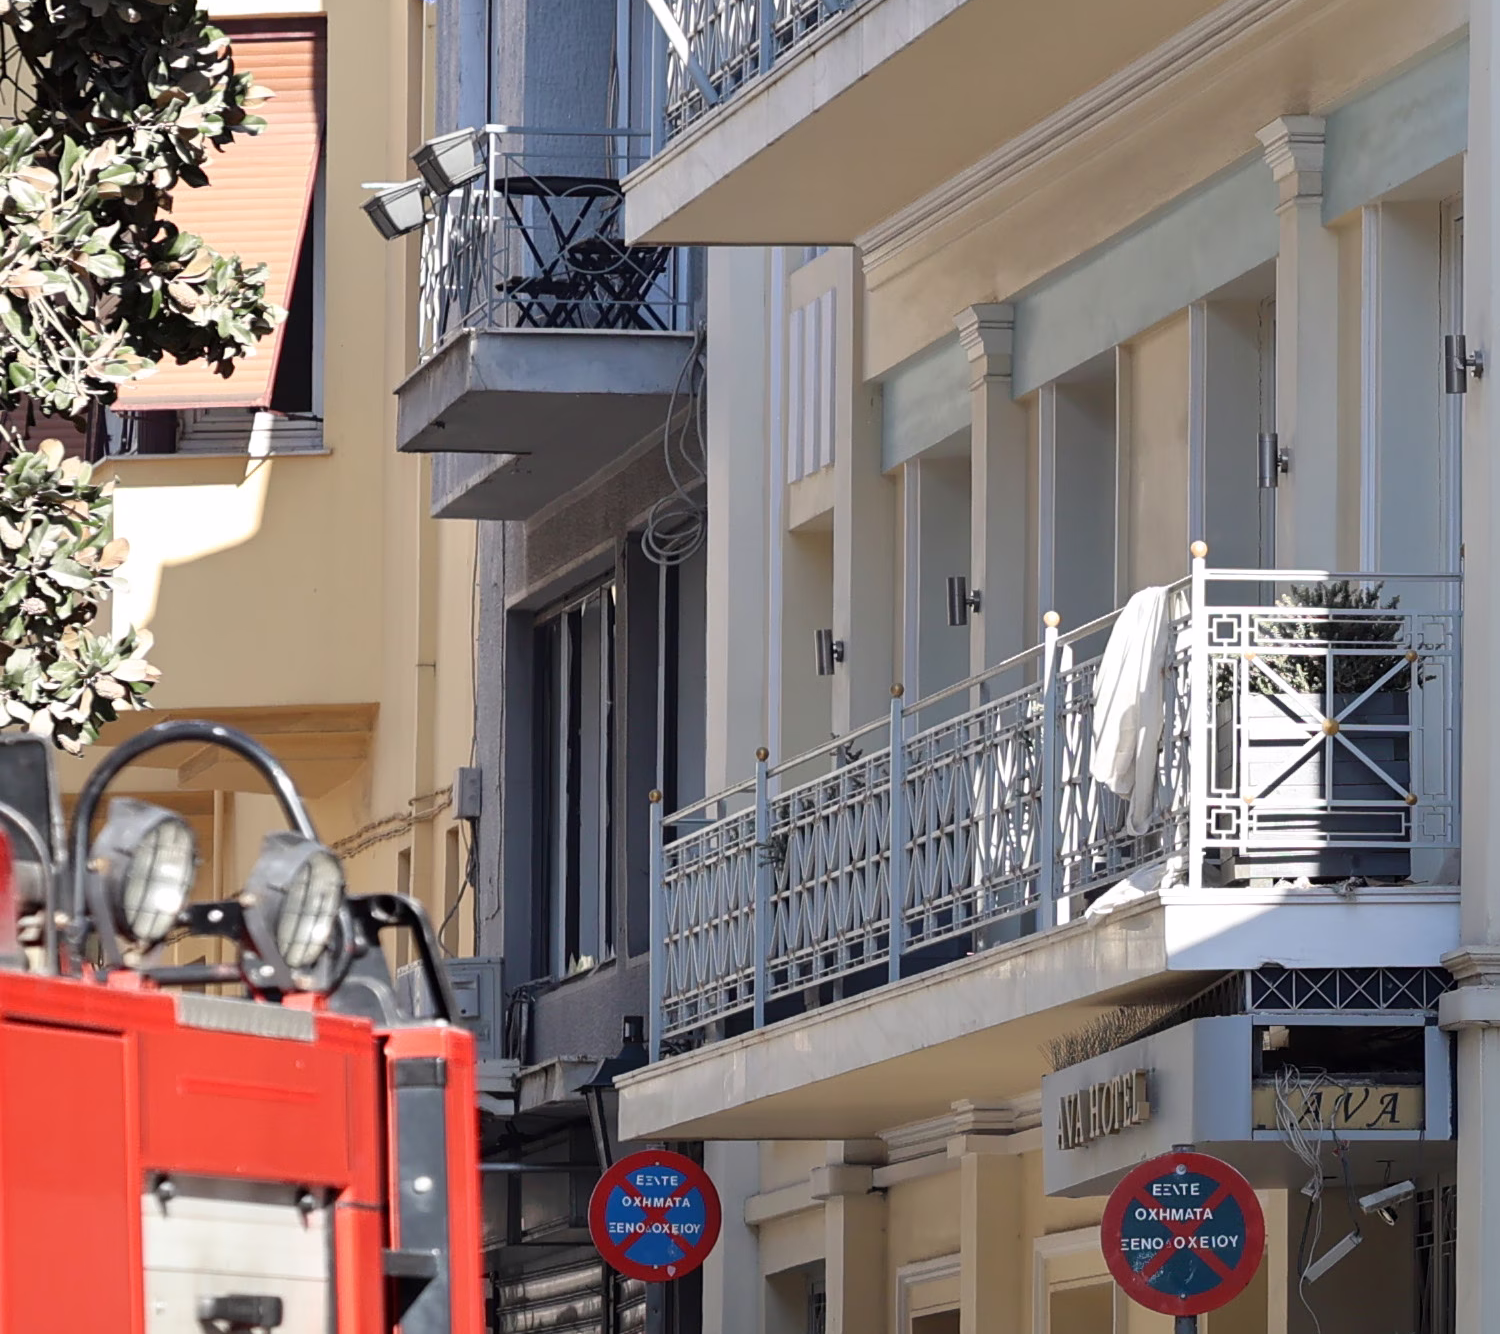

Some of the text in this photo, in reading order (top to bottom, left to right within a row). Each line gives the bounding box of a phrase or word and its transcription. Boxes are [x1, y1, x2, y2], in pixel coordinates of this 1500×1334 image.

[1056, 1068, 1147, 1151] AVA HOTEL
[1298, 1087, 1401, 1128] AVA
[621, 1196, 691, 1209] ΟΧΗΜΑΤΑ
[1134, 1207, 1214, 1221] ΟΧΗΜΑΤΑ
